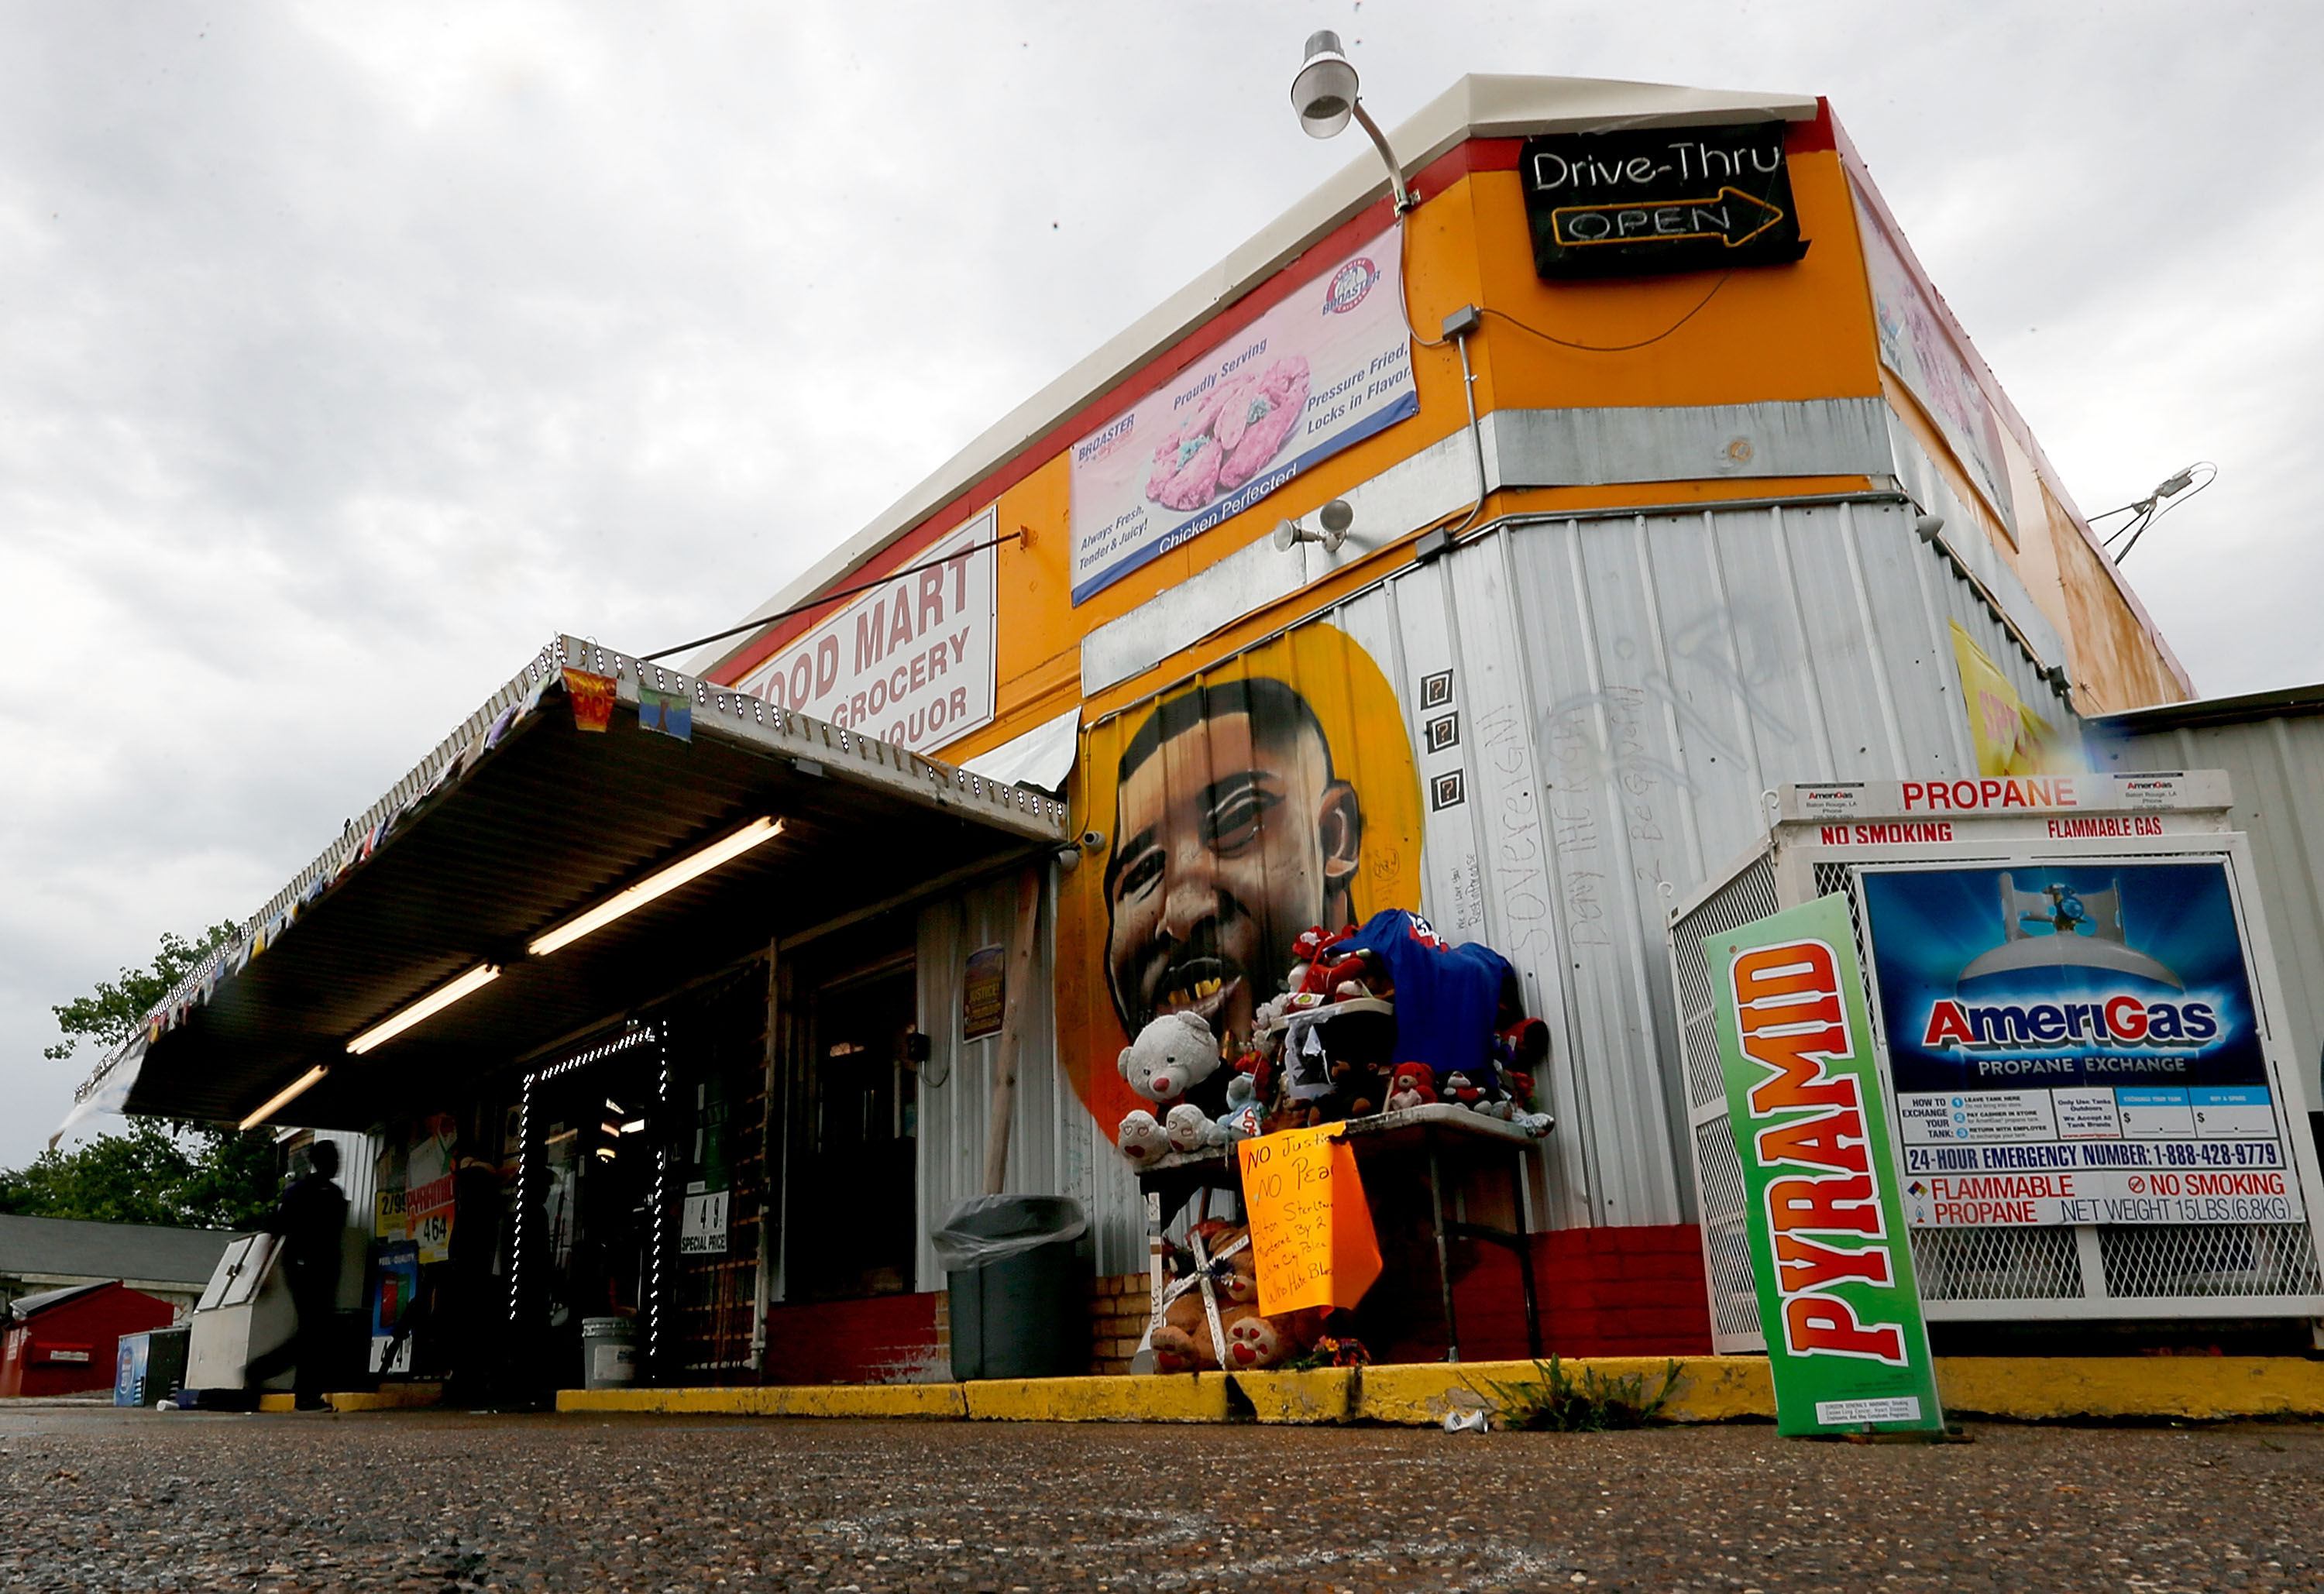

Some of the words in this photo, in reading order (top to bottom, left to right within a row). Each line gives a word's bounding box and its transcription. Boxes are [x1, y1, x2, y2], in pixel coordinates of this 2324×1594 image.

[1532, 142, 1780, 191] Drive-Thru
[1569, 206, 1731, 241] OPEN
[1322, 270, 1380, 315] BROASTER
[1174, 372, 1217, 411] Proudly
[1221, 338, 1267, 377] Serving
[1307, 369, 1365, 412] Pressure
[1307, 404, 1346, 435] Locks
[1349, 394, 1363, 411] in
[1367, 365, 1411, 400] Flavor.
[1078, 413, 1135, 462] BROASTER
[1159, 513, 1217, 547] Chicken
[1222, 462, 1297, 520] Perfected
[1081, 524, 1113, 551] Always
[1119, 517, 1148, 545] Juicy!
[747, 633, 839, 713] OOD
[854, 540, 975, 675] MART
[831, 625, 971, 729] GROCERY
[1901, 778, 2078, 811] PROPANE
[1820, 825, 1850, 846] NO
[1855, 823, 1953, 843] SMOKING
[2047, 817, 2132, 839] FLAMMABLE
[2135, 816, 2163, 836] GAS
[1922, 995, 2219, 1048] AmeriGas
[1978, 1057, 2075, 1077] PROPANE
[2085, 1056, 2187, 1074] EXCHANGE
[1902, 1109, 1948, 1118] EXCHANGE
[1913, 1098, 1932, 1107] HOW
[1934, 1098, 1946, 1107] TO
[1926, 1119, 1950, 1128] YOUR
[2123, 1112, 2131, 1123] $
[2197, 1111, 2205, 1123] $
[1928, 1129, 1954, 1139] TANK:
[1247, 1146, 1270, 1180] NO
[1730, 938, 1909, 1366] PYRAMID
[1910, 1147, 1978, 1170] 24-HOUR
[1982, 1145, 2077, 1169] EMERGENCY
[2082, 1143, 2152, 1166] NUMBER:
[2154, 1142, 2277, 1166] 1-888-428-9779
[1257, 1173, 1282, 1208] NO
[1930, 1174, 2075, 1201] FLAMMABLE
[2150, 1173, 2181, 1196] NO
[2185, 1173, 2285, 1196] SMOKING
[1316, 1215, 1327, 1229] 2
[1934, 1201, 2038, 1225] PROPANE
[2061, 1198, 2100, 1222] NET
[2104, 1197, 2171, 1221] WEIGHT
[423, 1215, 448, 1242] 464
[682, 1235, 706, 1252] SPECIAL
[708, 1233, 726, 1250] PRICE
